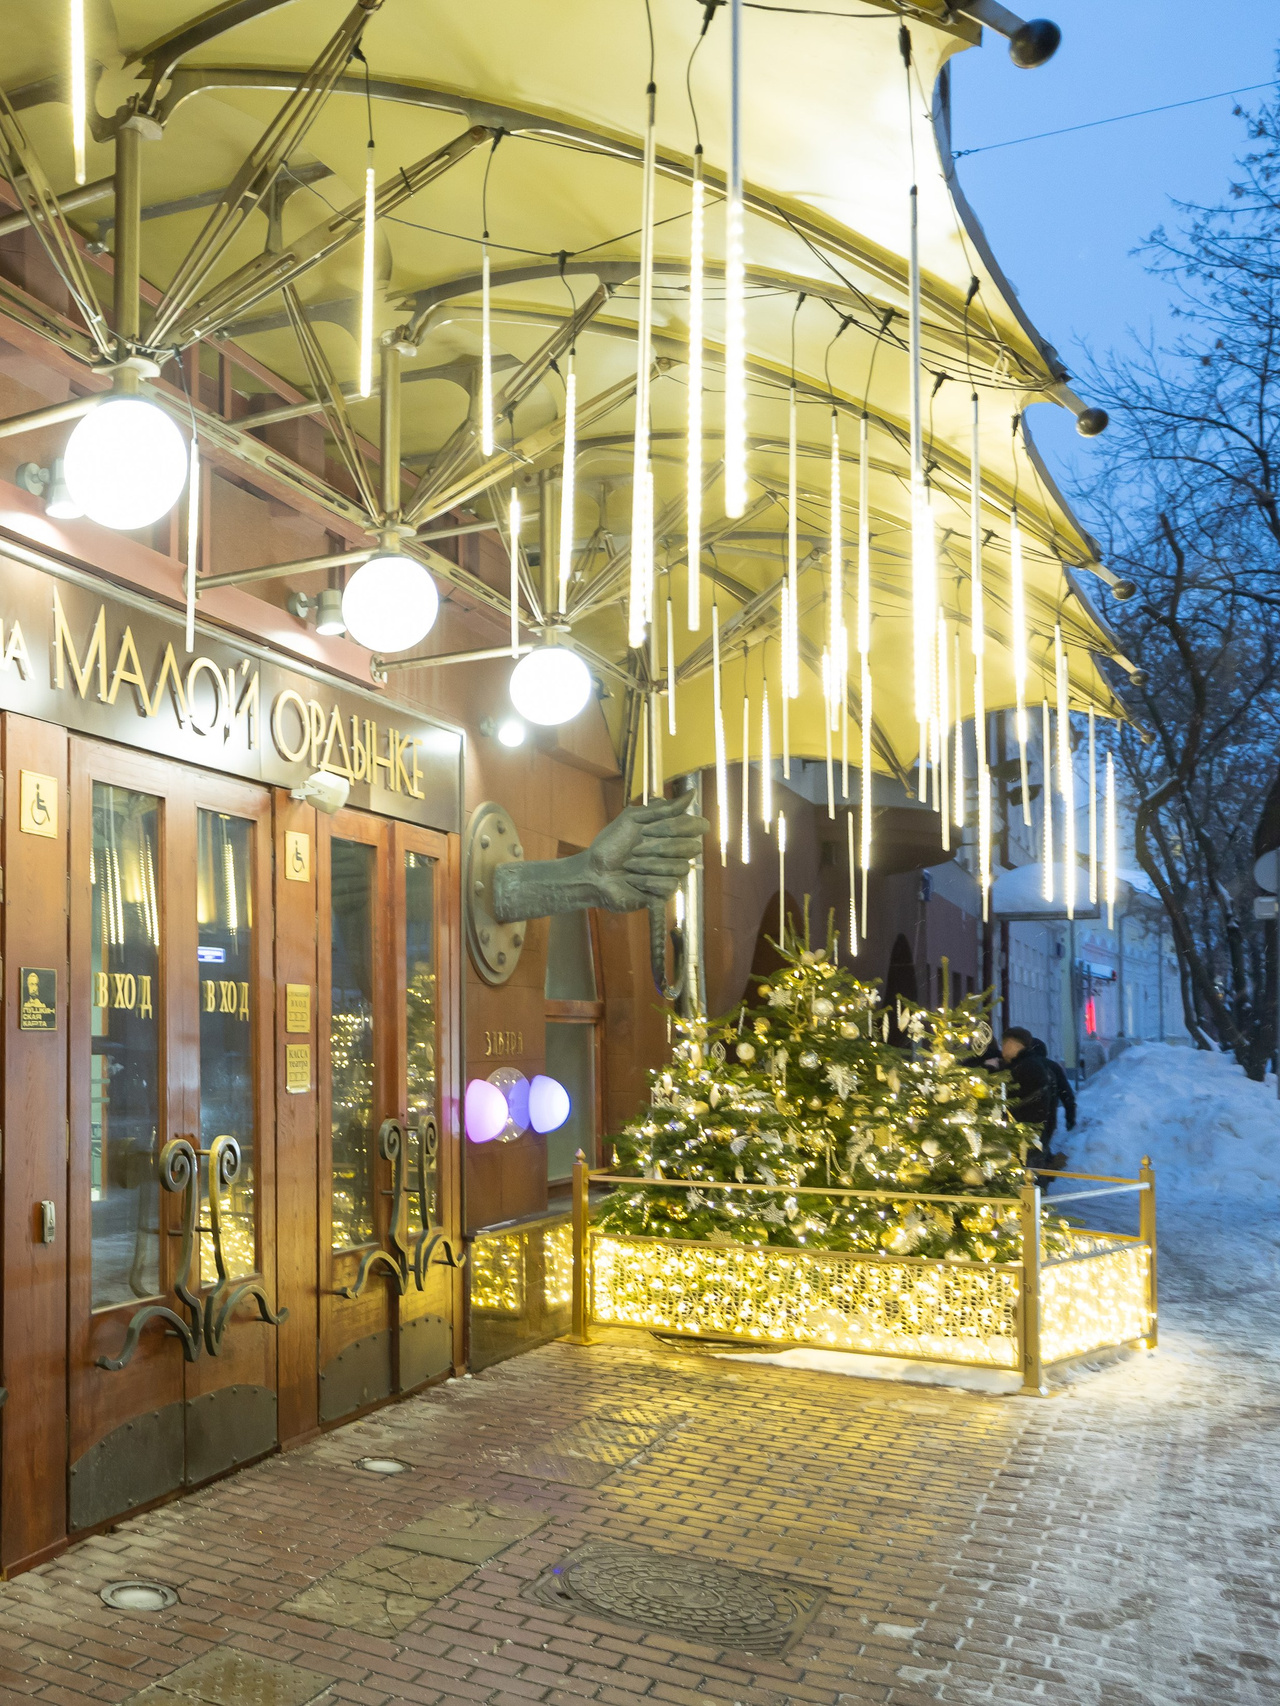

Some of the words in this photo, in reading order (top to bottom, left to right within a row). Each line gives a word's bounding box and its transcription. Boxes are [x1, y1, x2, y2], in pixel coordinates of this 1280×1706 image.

[53, 584, 260, 751] МАЛОЙ
[274, 688, 426, 800] ОРДЫНКЕ
[97, 971, 153, 1020] ВХОД
[205, 979, 250, 1021] ВХОД
